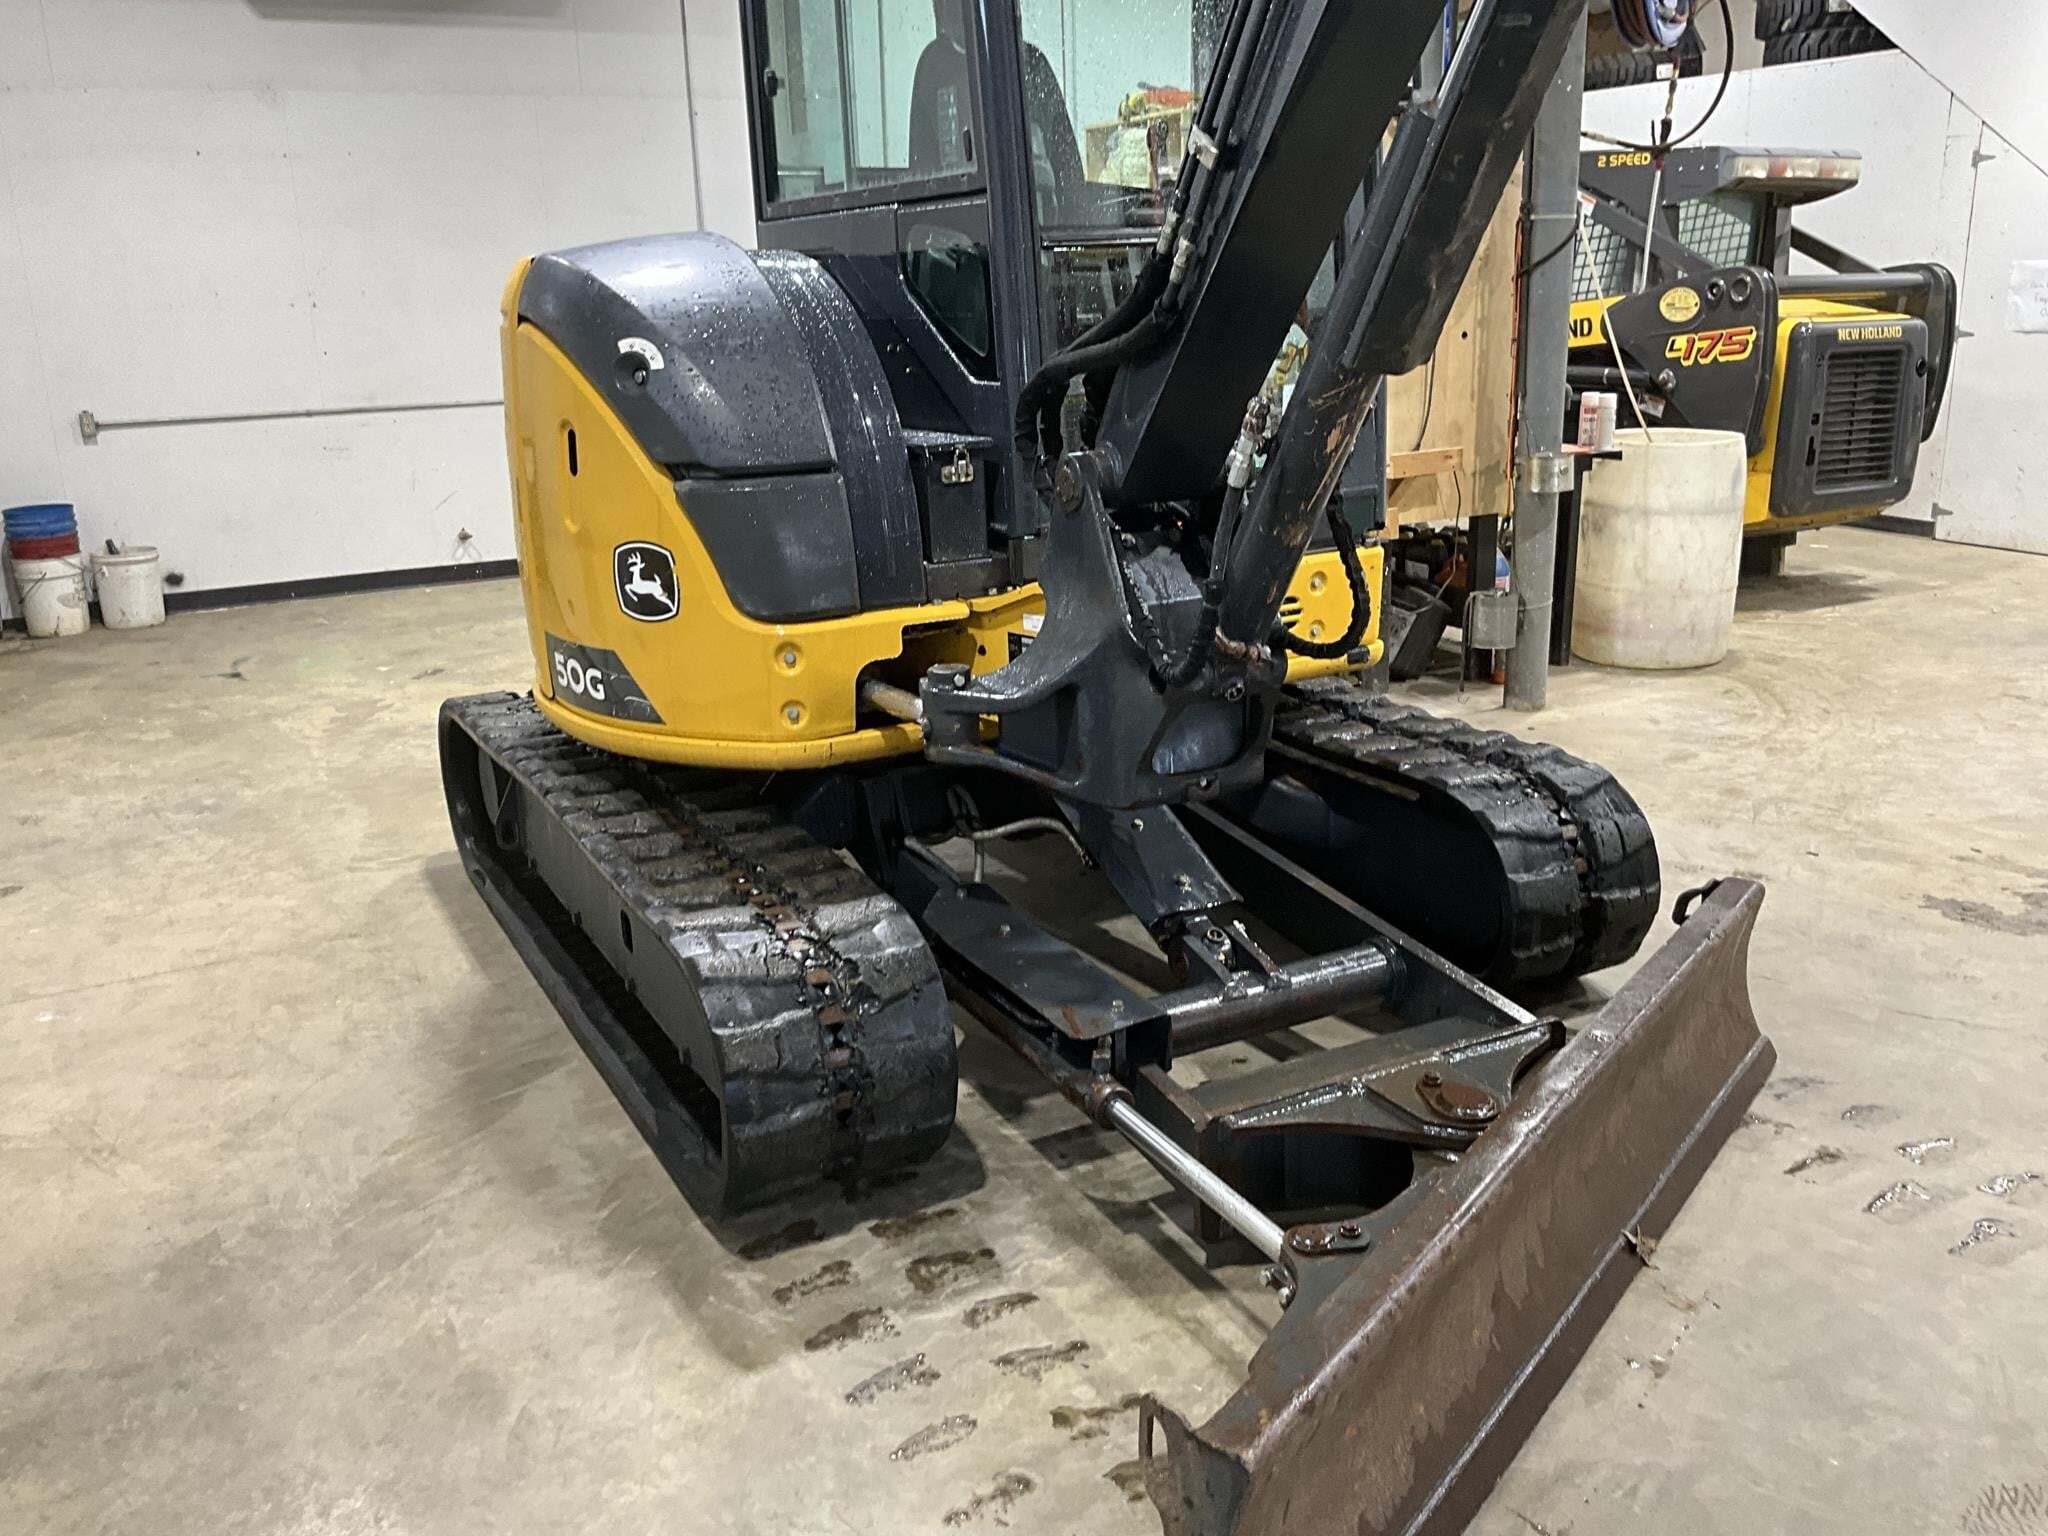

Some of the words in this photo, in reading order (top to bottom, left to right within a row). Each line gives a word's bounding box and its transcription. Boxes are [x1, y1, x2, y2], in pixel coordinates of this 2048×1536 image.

[1597, 155, 1607, 168] 2
[1609, 152, 1651, 167] SPEED
[1665, 325, 1756, 366] L175
[1837, 327, 1860, 341] NEW
[1861, 325, 1903, 340] HOLLAND
[553, 650, 606, 701] 50G
